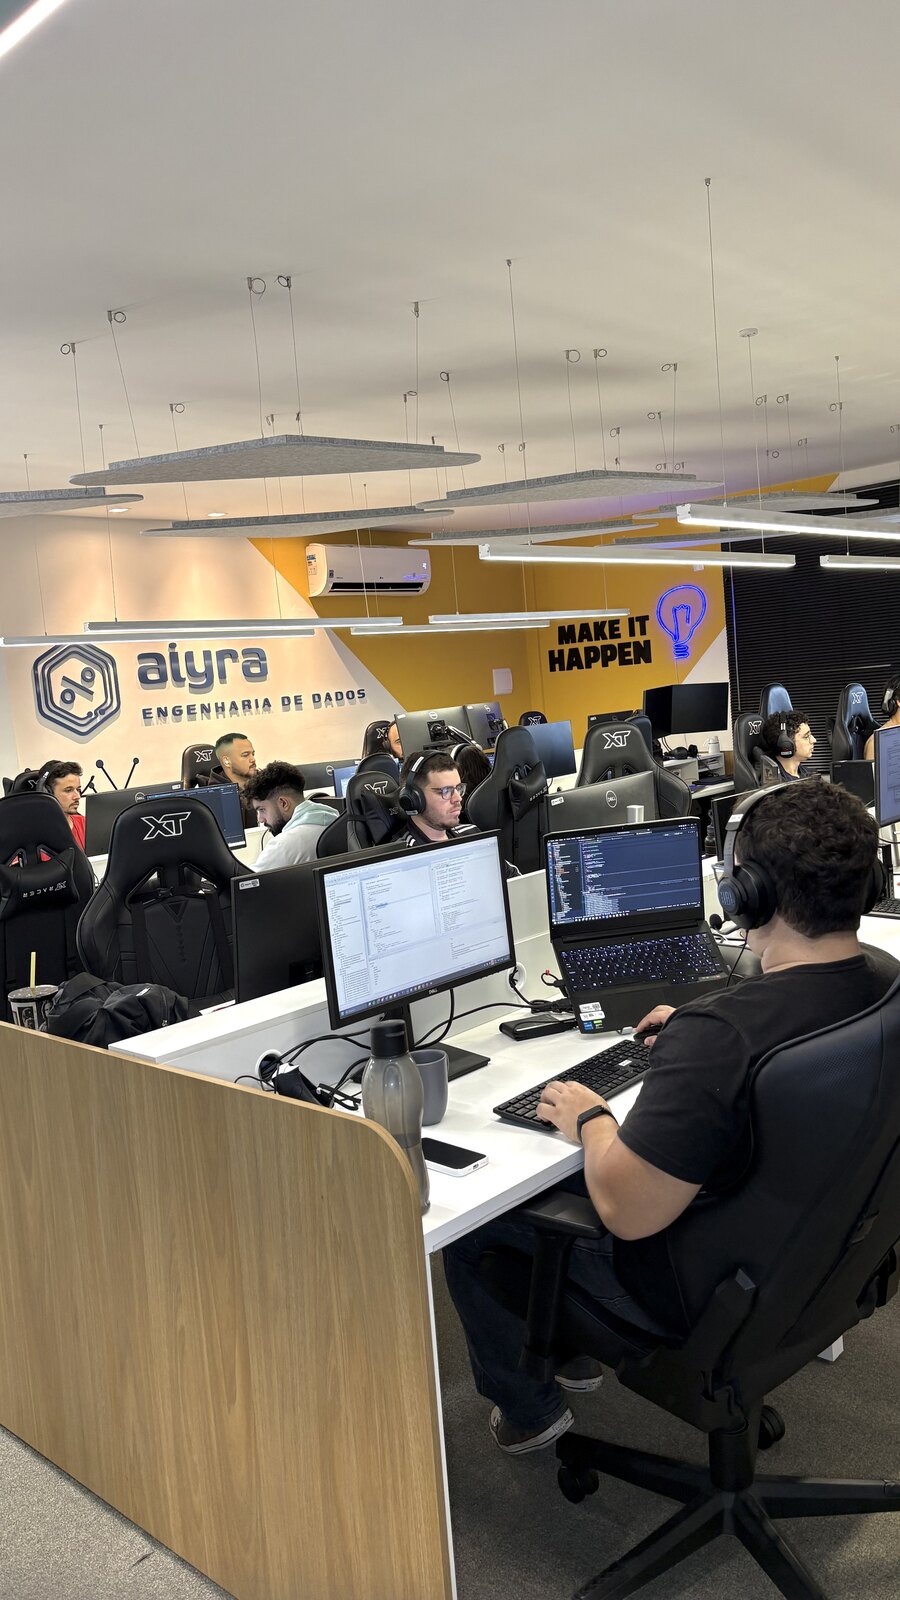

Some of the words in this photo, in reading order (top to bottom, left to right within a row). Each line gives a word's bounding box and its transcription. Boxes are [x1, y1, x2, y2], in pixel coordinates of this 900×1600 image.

[557, 618, 621, 645] MAKE
[628, 615, 649, 637] IT
[137, 642, 269, 691] aiyra
[548, 640, 652, 672] HAPPEN
[142, 697, 272, 720] ENGENHARIA
[281, 694, 303, 706] DE
[312, 688, 366, 703] DADOS
[602, 730, 632, 750] XT
[748, 720, 762, 735] XT
[194, 749, 214, 763] XT
[140, 811, 191, 841] XT
